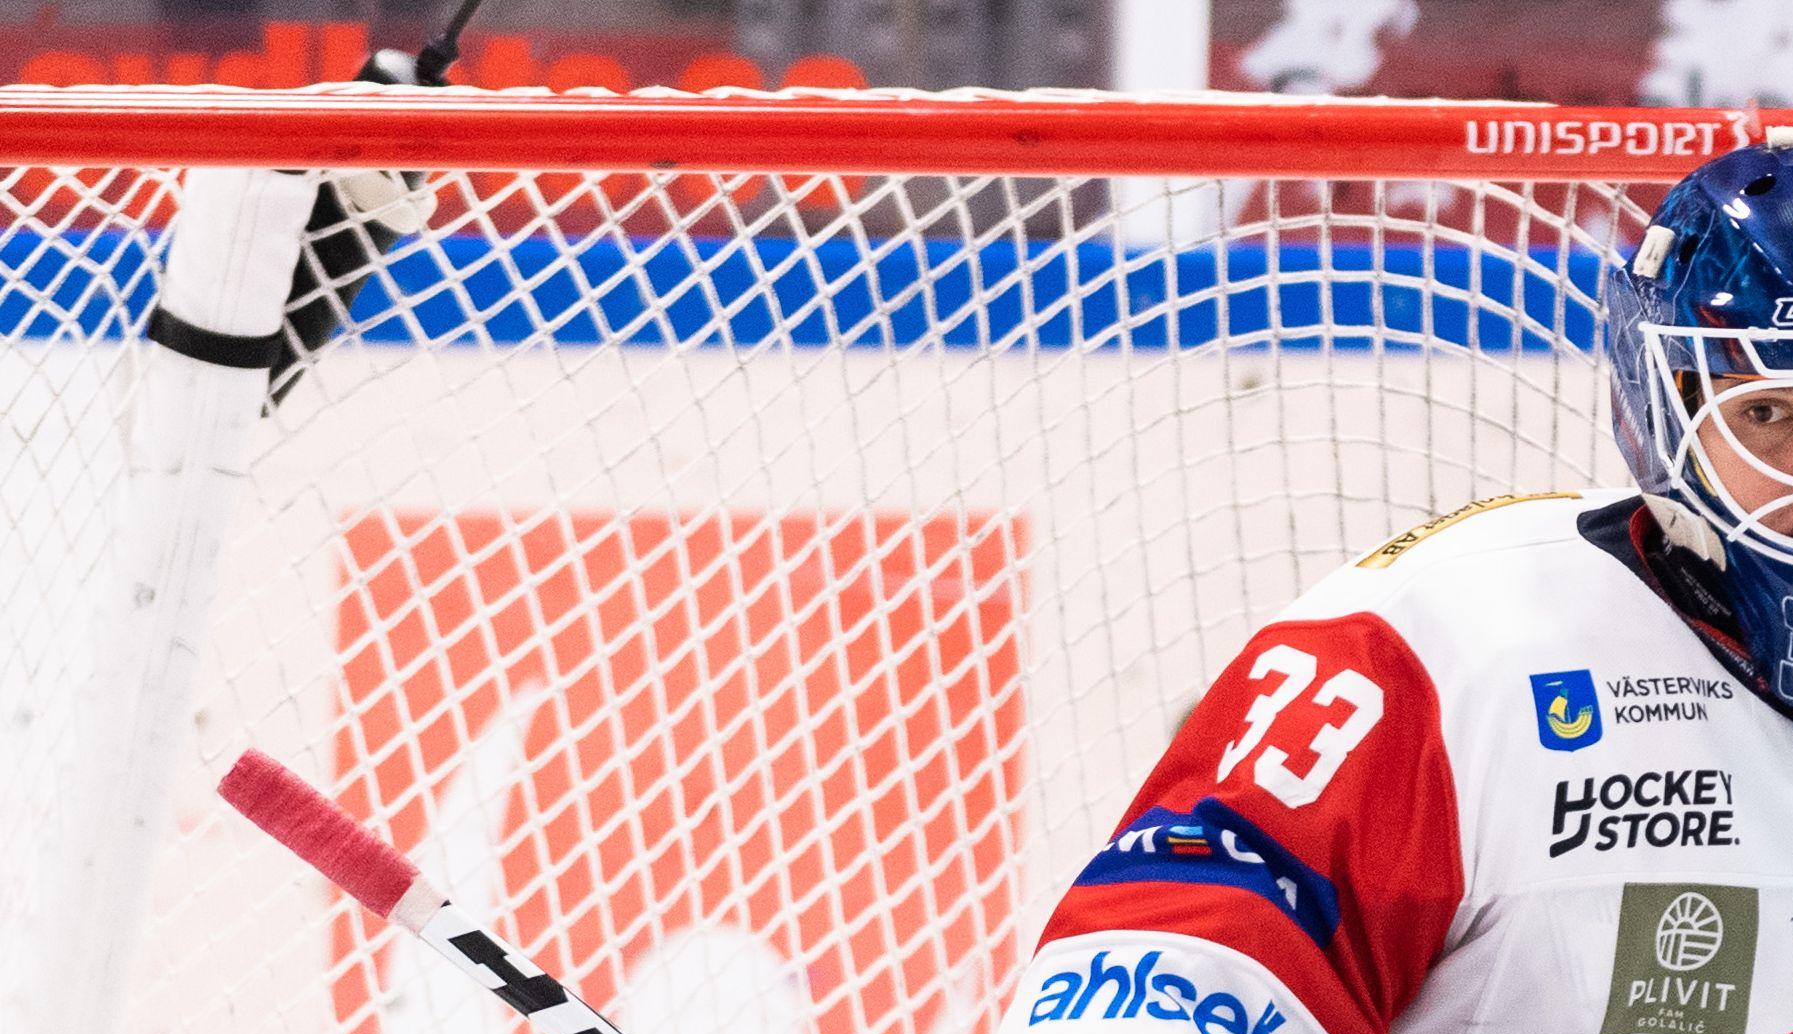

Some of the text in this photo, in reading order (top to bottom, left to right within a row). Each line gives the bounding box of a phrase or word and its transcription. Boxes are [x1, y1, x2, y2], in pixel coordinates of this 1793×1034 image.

[1465, 119, 1721, 156] UNISPORT
[1606, 676, 1734, 700] VÄSTERVIKS
[1217, 644, 1384, 809] 33
[1614, 702, 1708, 724] KOMMUN
[1551, 769, 1733, 845] HOCKEY
[1628, 976, 1736, 1011] PLIVIT
[1658, 1008, 1684, 1018] FAM
